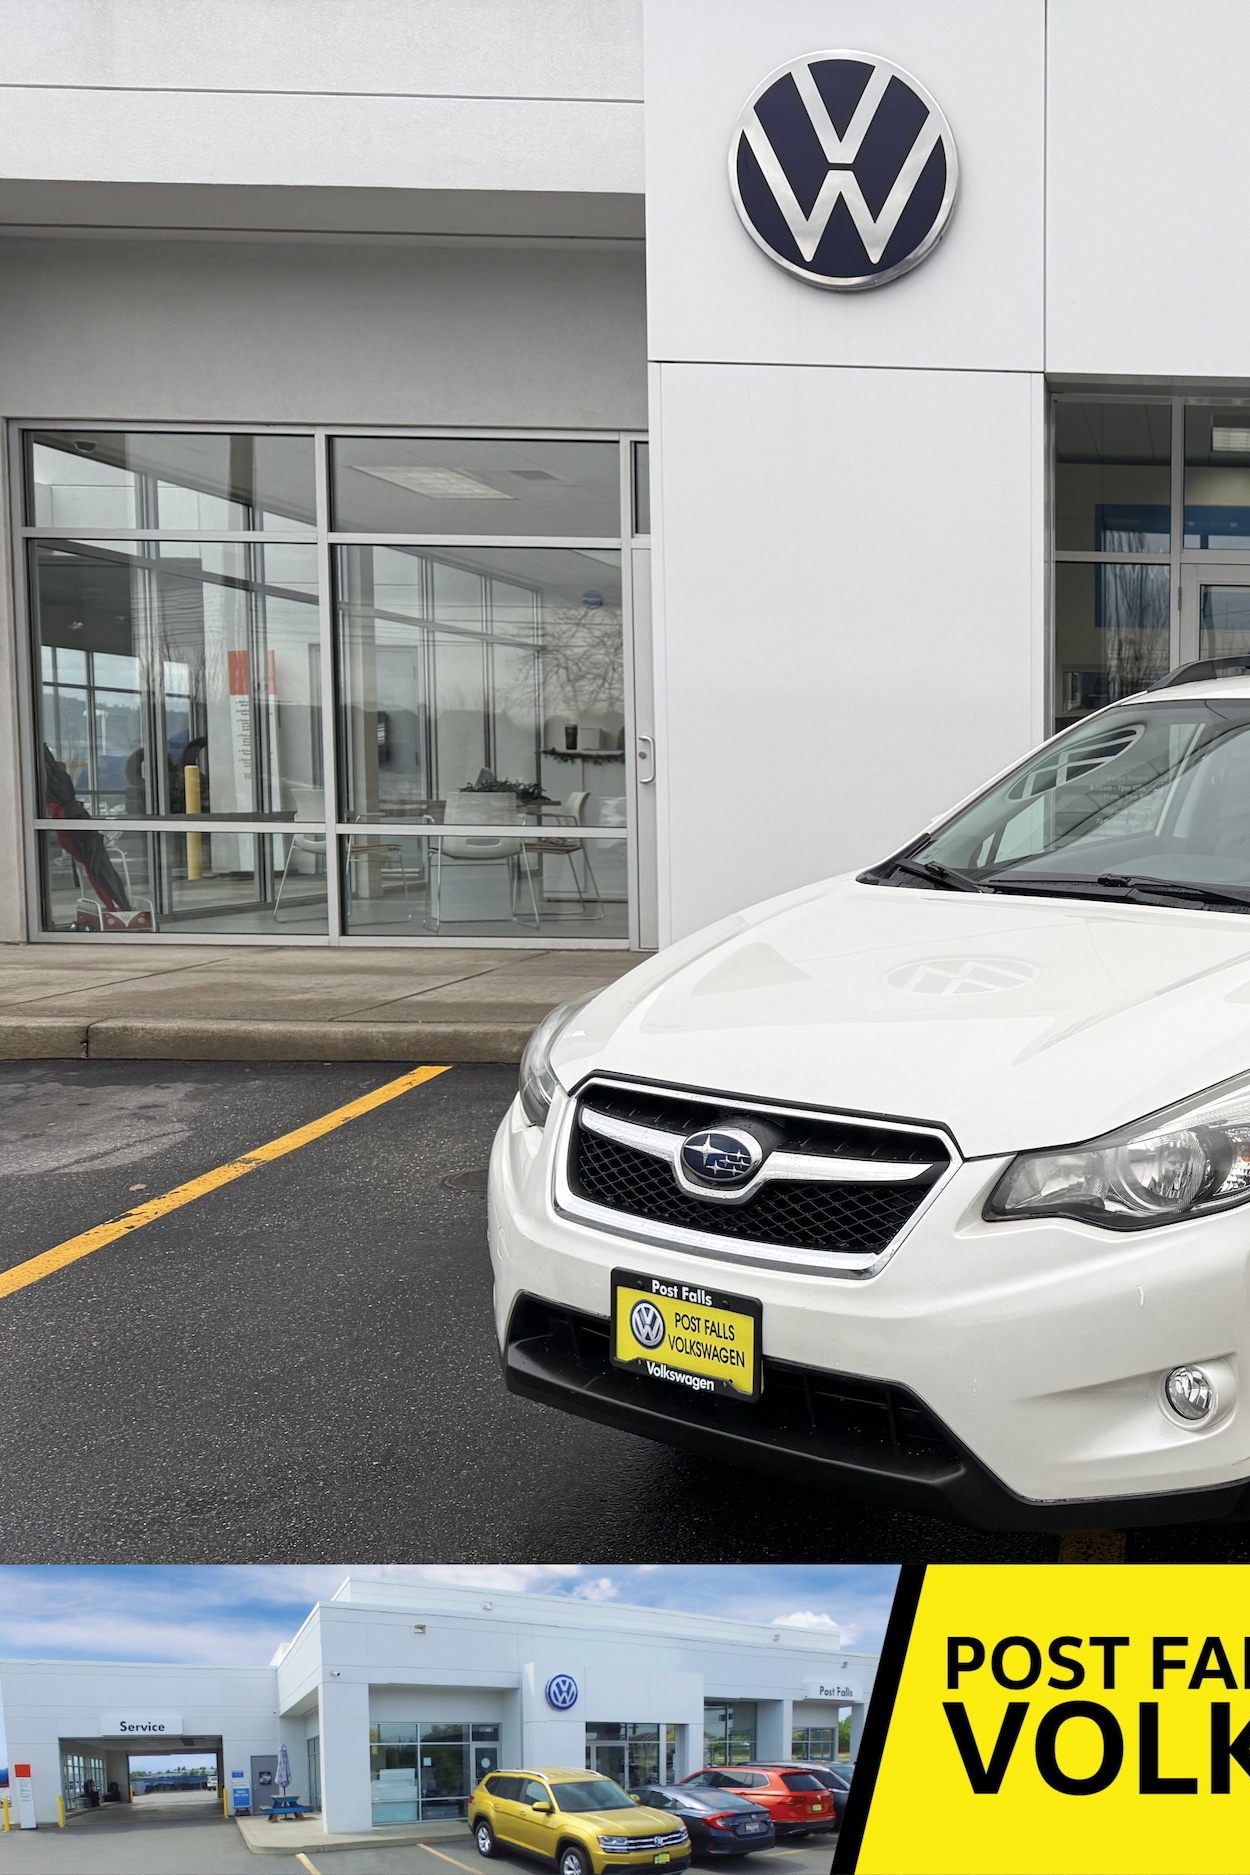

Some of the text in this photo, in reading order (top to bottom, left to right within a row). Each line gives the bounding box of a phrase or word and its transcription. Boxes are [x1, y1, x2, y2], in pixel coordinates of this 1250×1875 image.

[652, 1279, 712, 1306] Post Falls
[675, 1312, 735, 1341] POST FALLS
[668, 1334, 745, 1368] VOLKSWAGEN
[646, 1361, 715, 1391] Volkswagen
